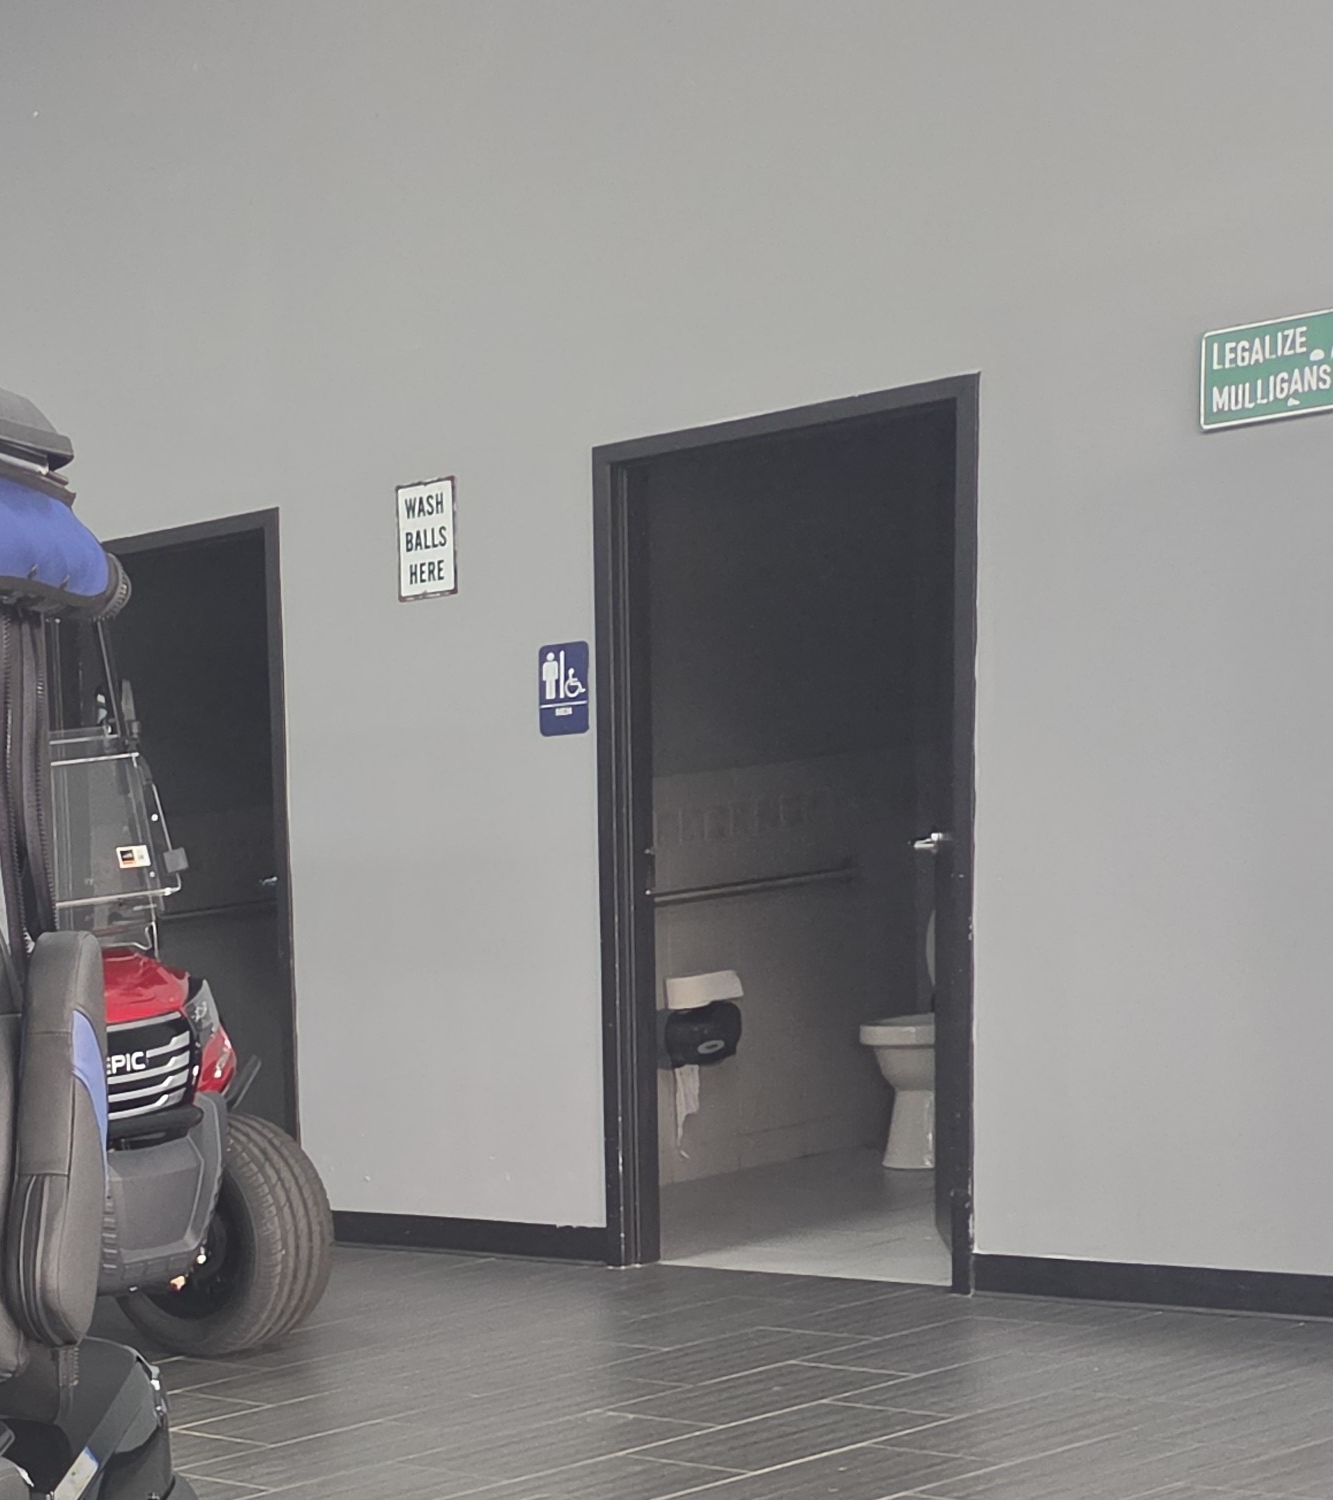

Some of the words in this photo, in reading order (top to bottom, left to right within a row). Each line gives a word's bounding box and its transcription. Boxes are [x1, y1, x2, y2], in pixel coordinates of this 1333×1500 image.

[1212, 326, 1308, 370] LEGALIZE
[1212, 364, 1332, 413] MULLIGANS
[404, 492, 444, 519] WASH
[405, 526, 447, 552] BALLS
[409, 560, 445, 585] HERE
